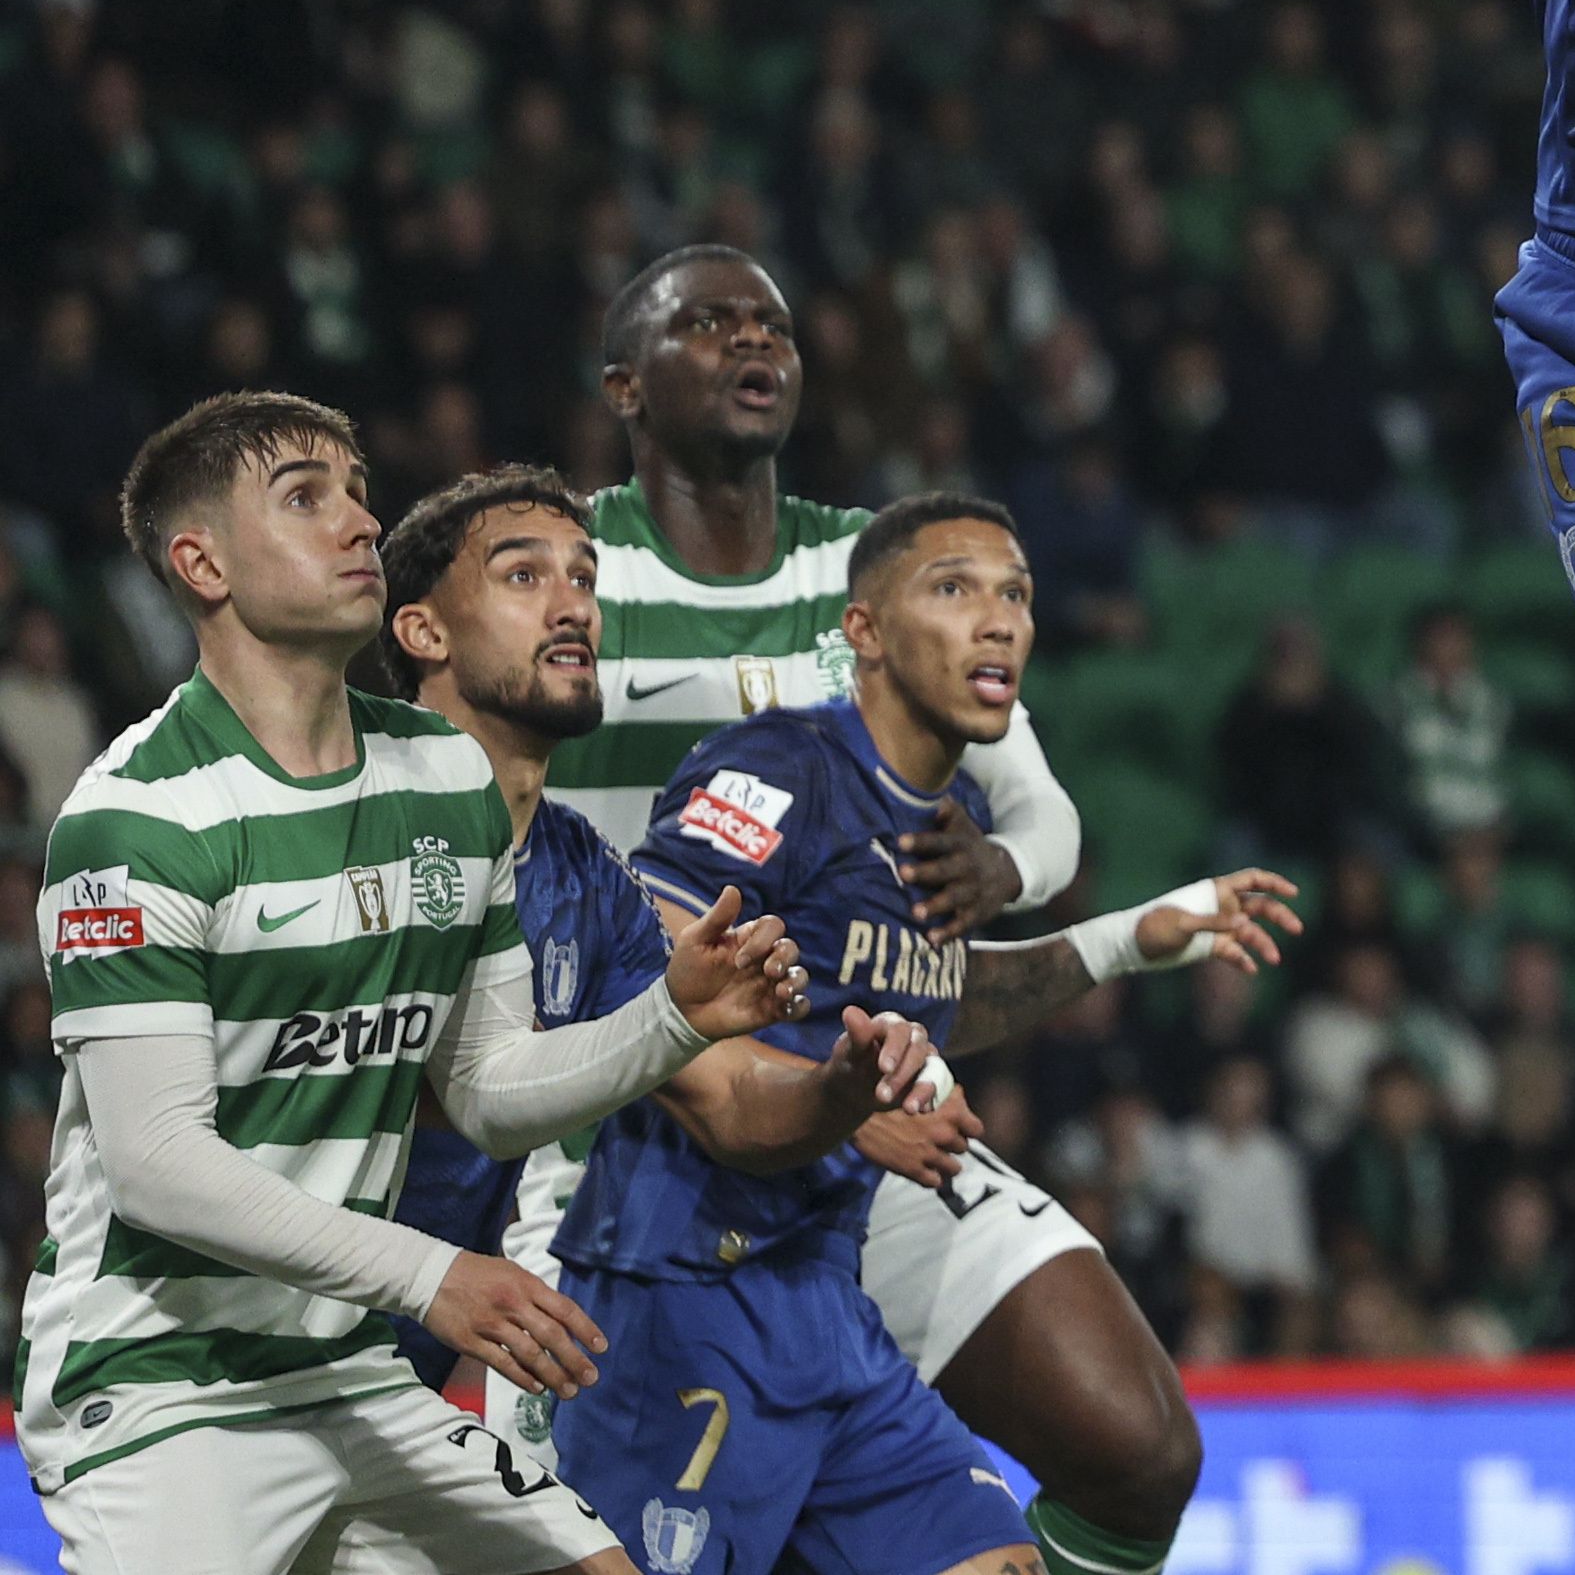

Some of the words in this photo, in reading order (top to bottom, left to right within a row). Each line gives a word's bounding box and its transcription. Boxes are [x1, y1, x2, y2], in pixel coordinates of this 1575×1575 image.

[412, 835, 449, 855] SCP
[686, 797, 767, 856] Betclic
[674, 1387, 730, 1492] 7
